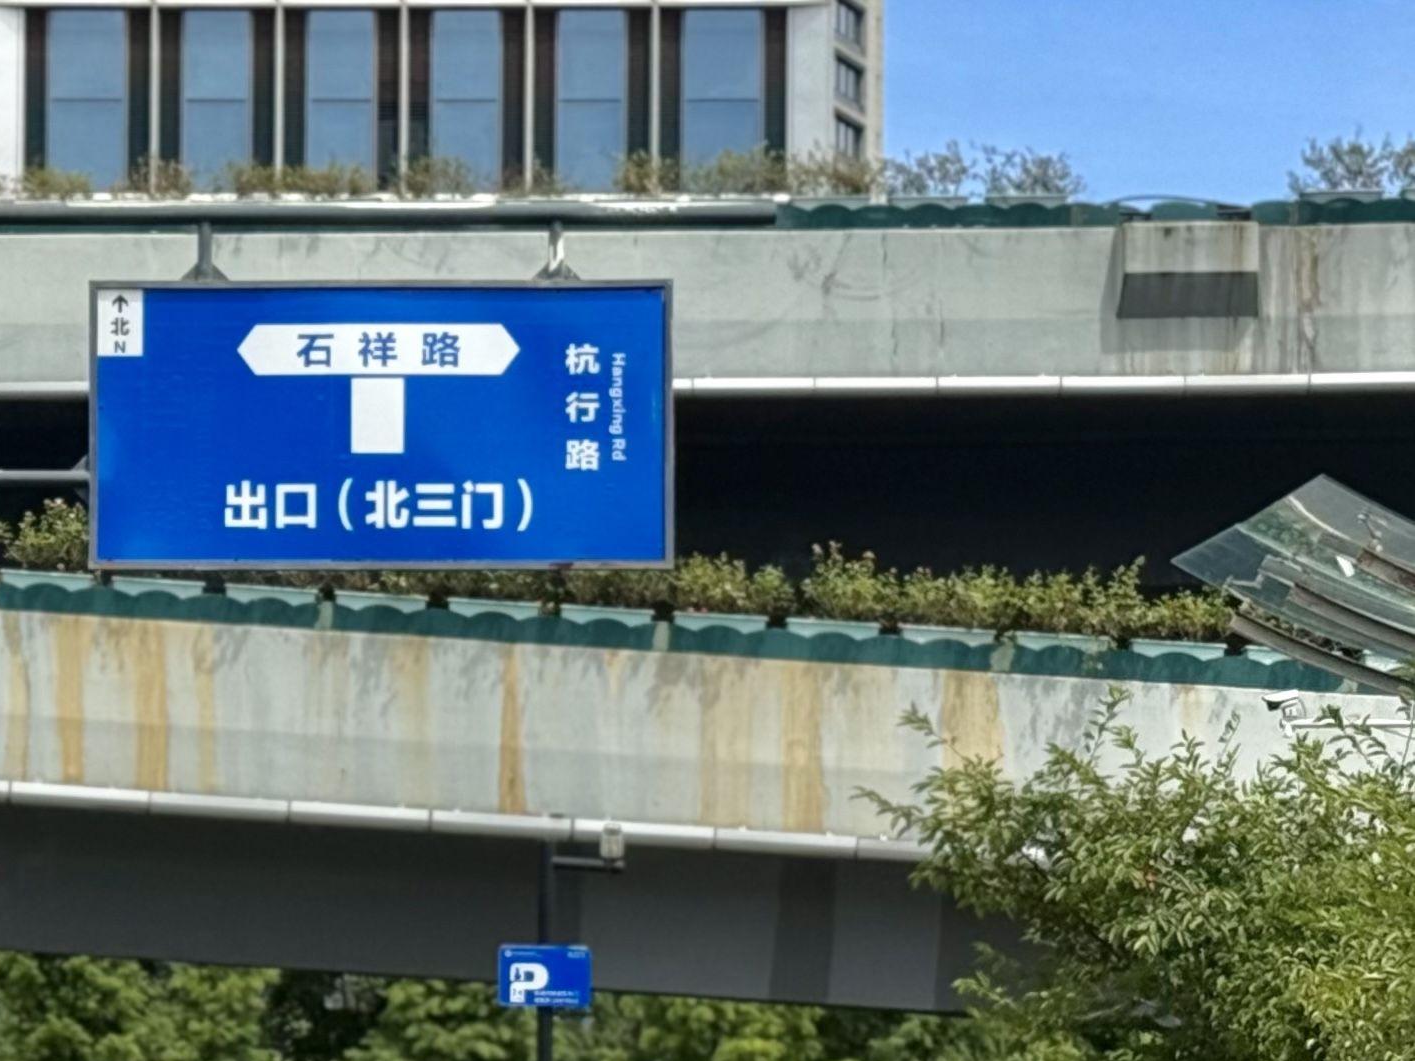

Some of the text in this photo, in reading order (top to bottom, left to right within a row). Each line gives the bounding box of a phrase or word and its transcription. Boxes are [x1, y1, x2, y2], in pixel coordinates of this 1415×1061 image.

[110, 316, 130, 336] 北
[114, 340, 126, 354] N
[296, 331, 461, 368] 石祥路
[565, 343, 601, 471] 杭行路
[608, 353, 626, 461] Hangxing Rd
[510, 963, 549, 1003] P
